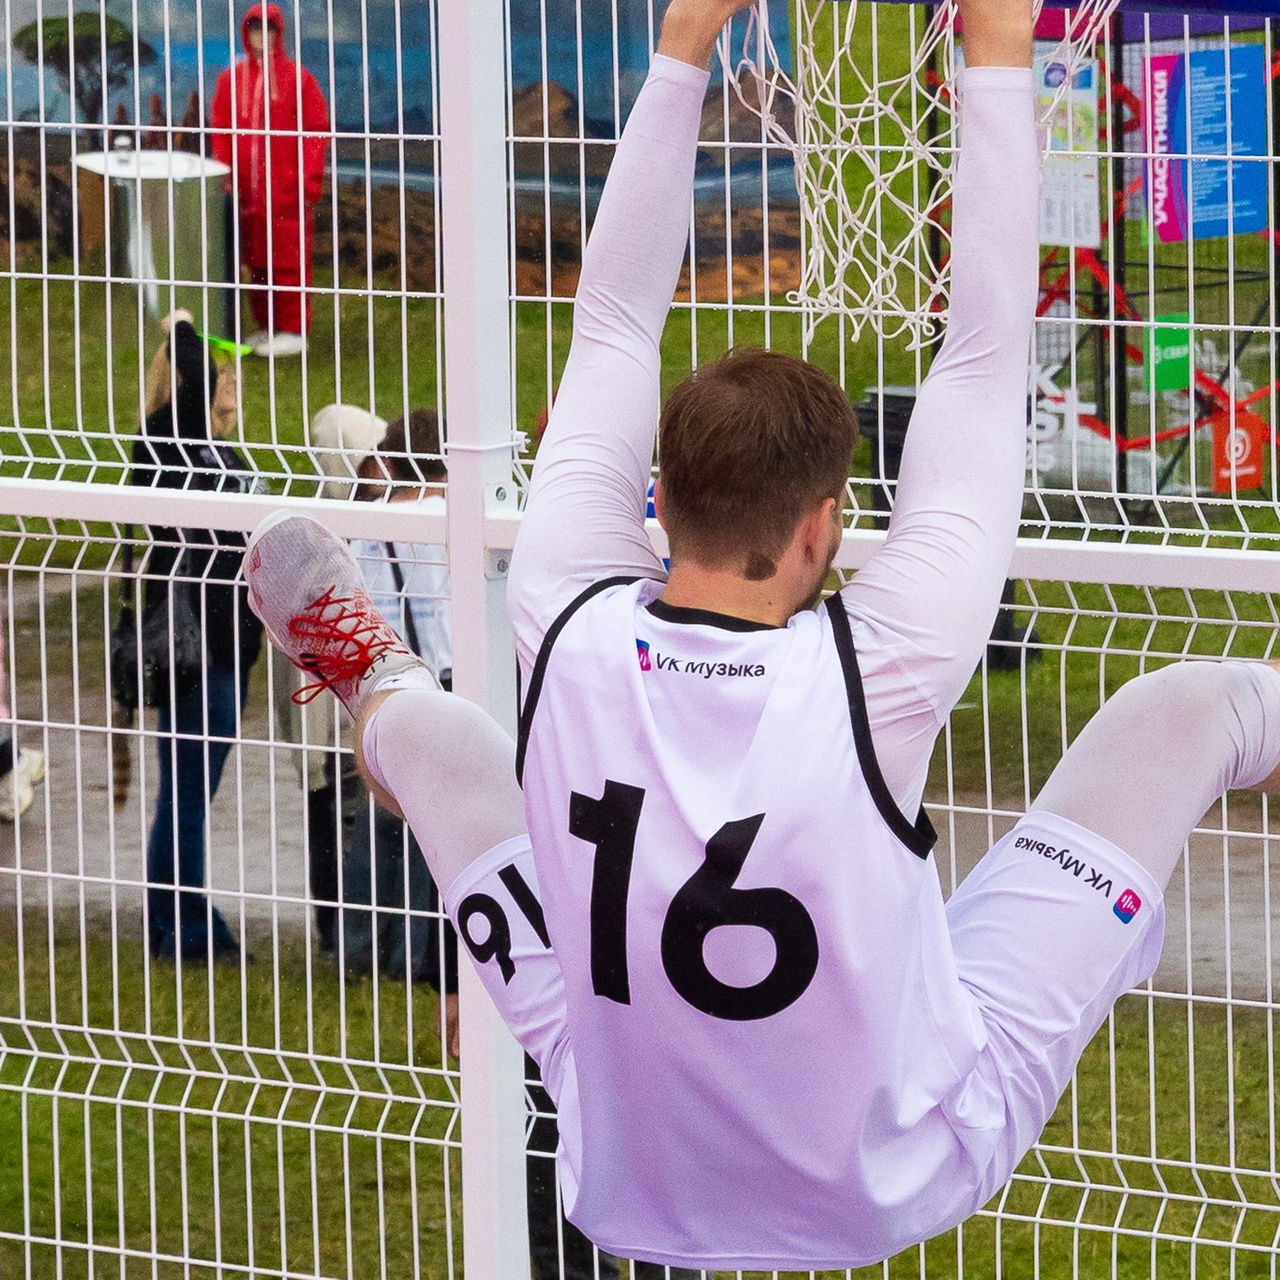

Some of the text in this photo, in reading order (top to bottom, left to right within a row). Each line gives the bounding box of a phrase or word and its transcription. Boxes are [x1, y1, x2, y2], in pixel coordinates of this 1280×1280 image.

[656, 652, 766, 680] VK Музыка
[1014, 836, 1113, 898] VK Музыка
[568, 778, 820, 1022] 16
